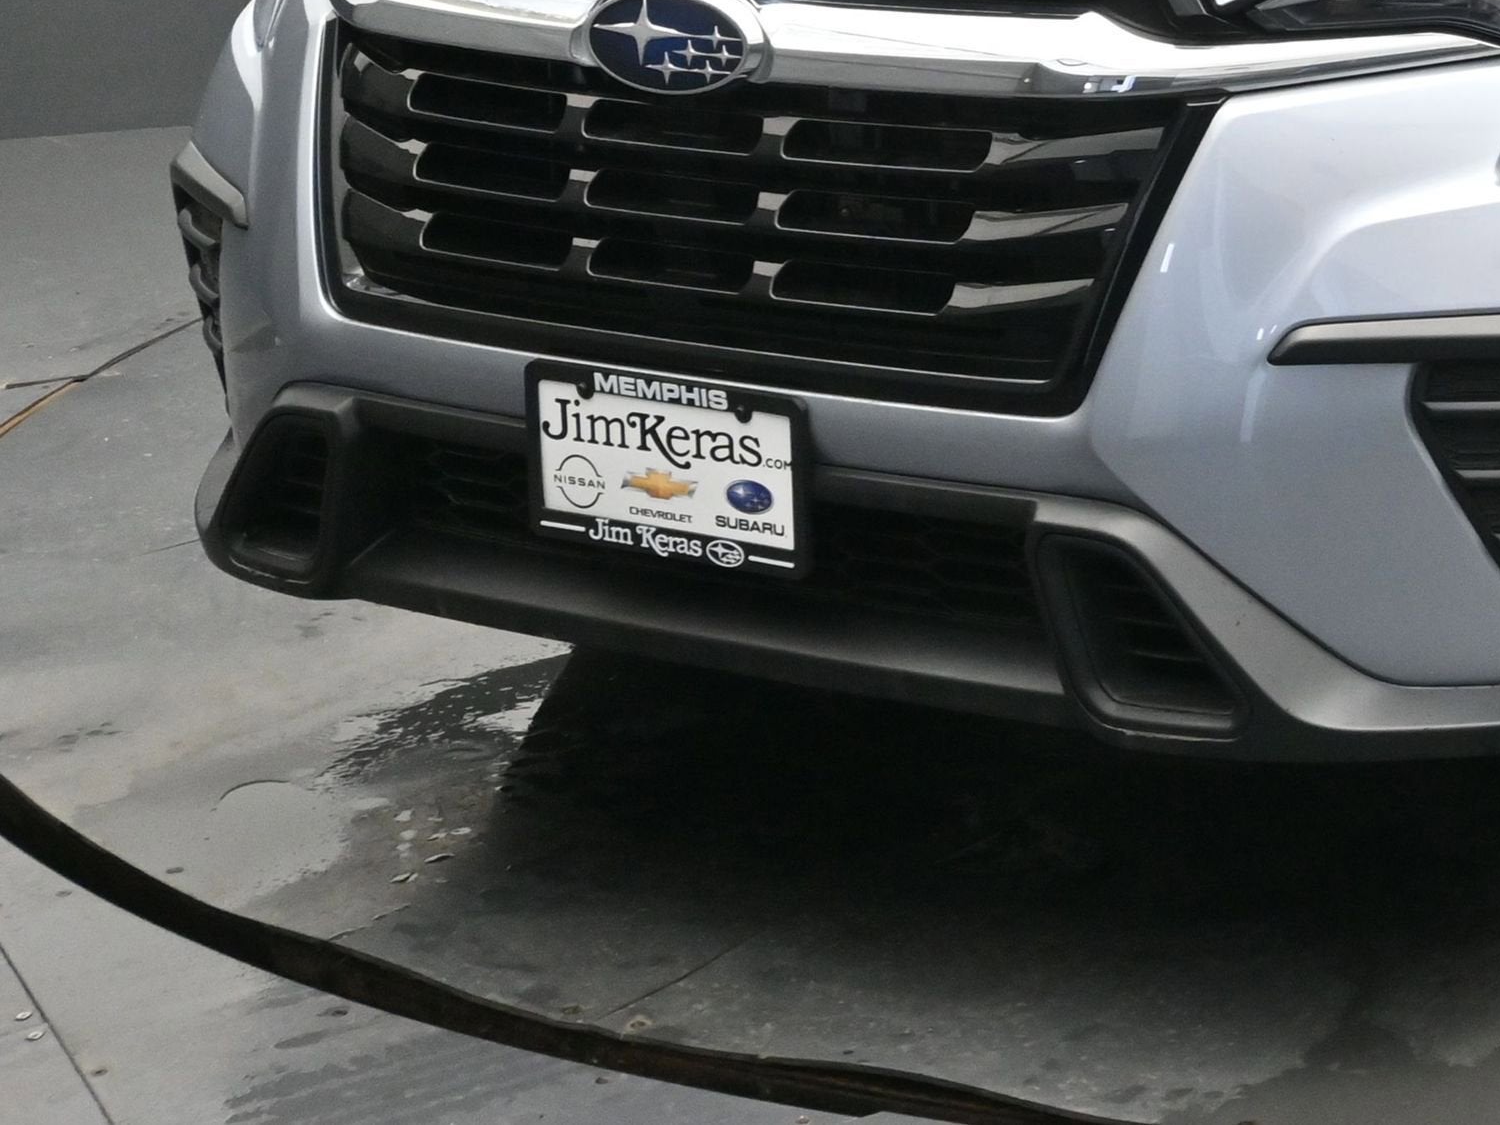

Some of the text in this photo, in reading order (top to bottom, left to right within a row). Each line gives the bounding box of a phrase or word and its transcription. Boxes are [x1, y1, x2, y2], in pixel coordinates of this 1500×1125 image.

[593, 372, 728, 411] MEMPHIS
[553, 474, 606, 490] NISSAN
[629, 506, 693, 523] CHEVROLET
[715, 515, 785, 537] SUBARU
[588, 518, 702, 557] Jim Keras
